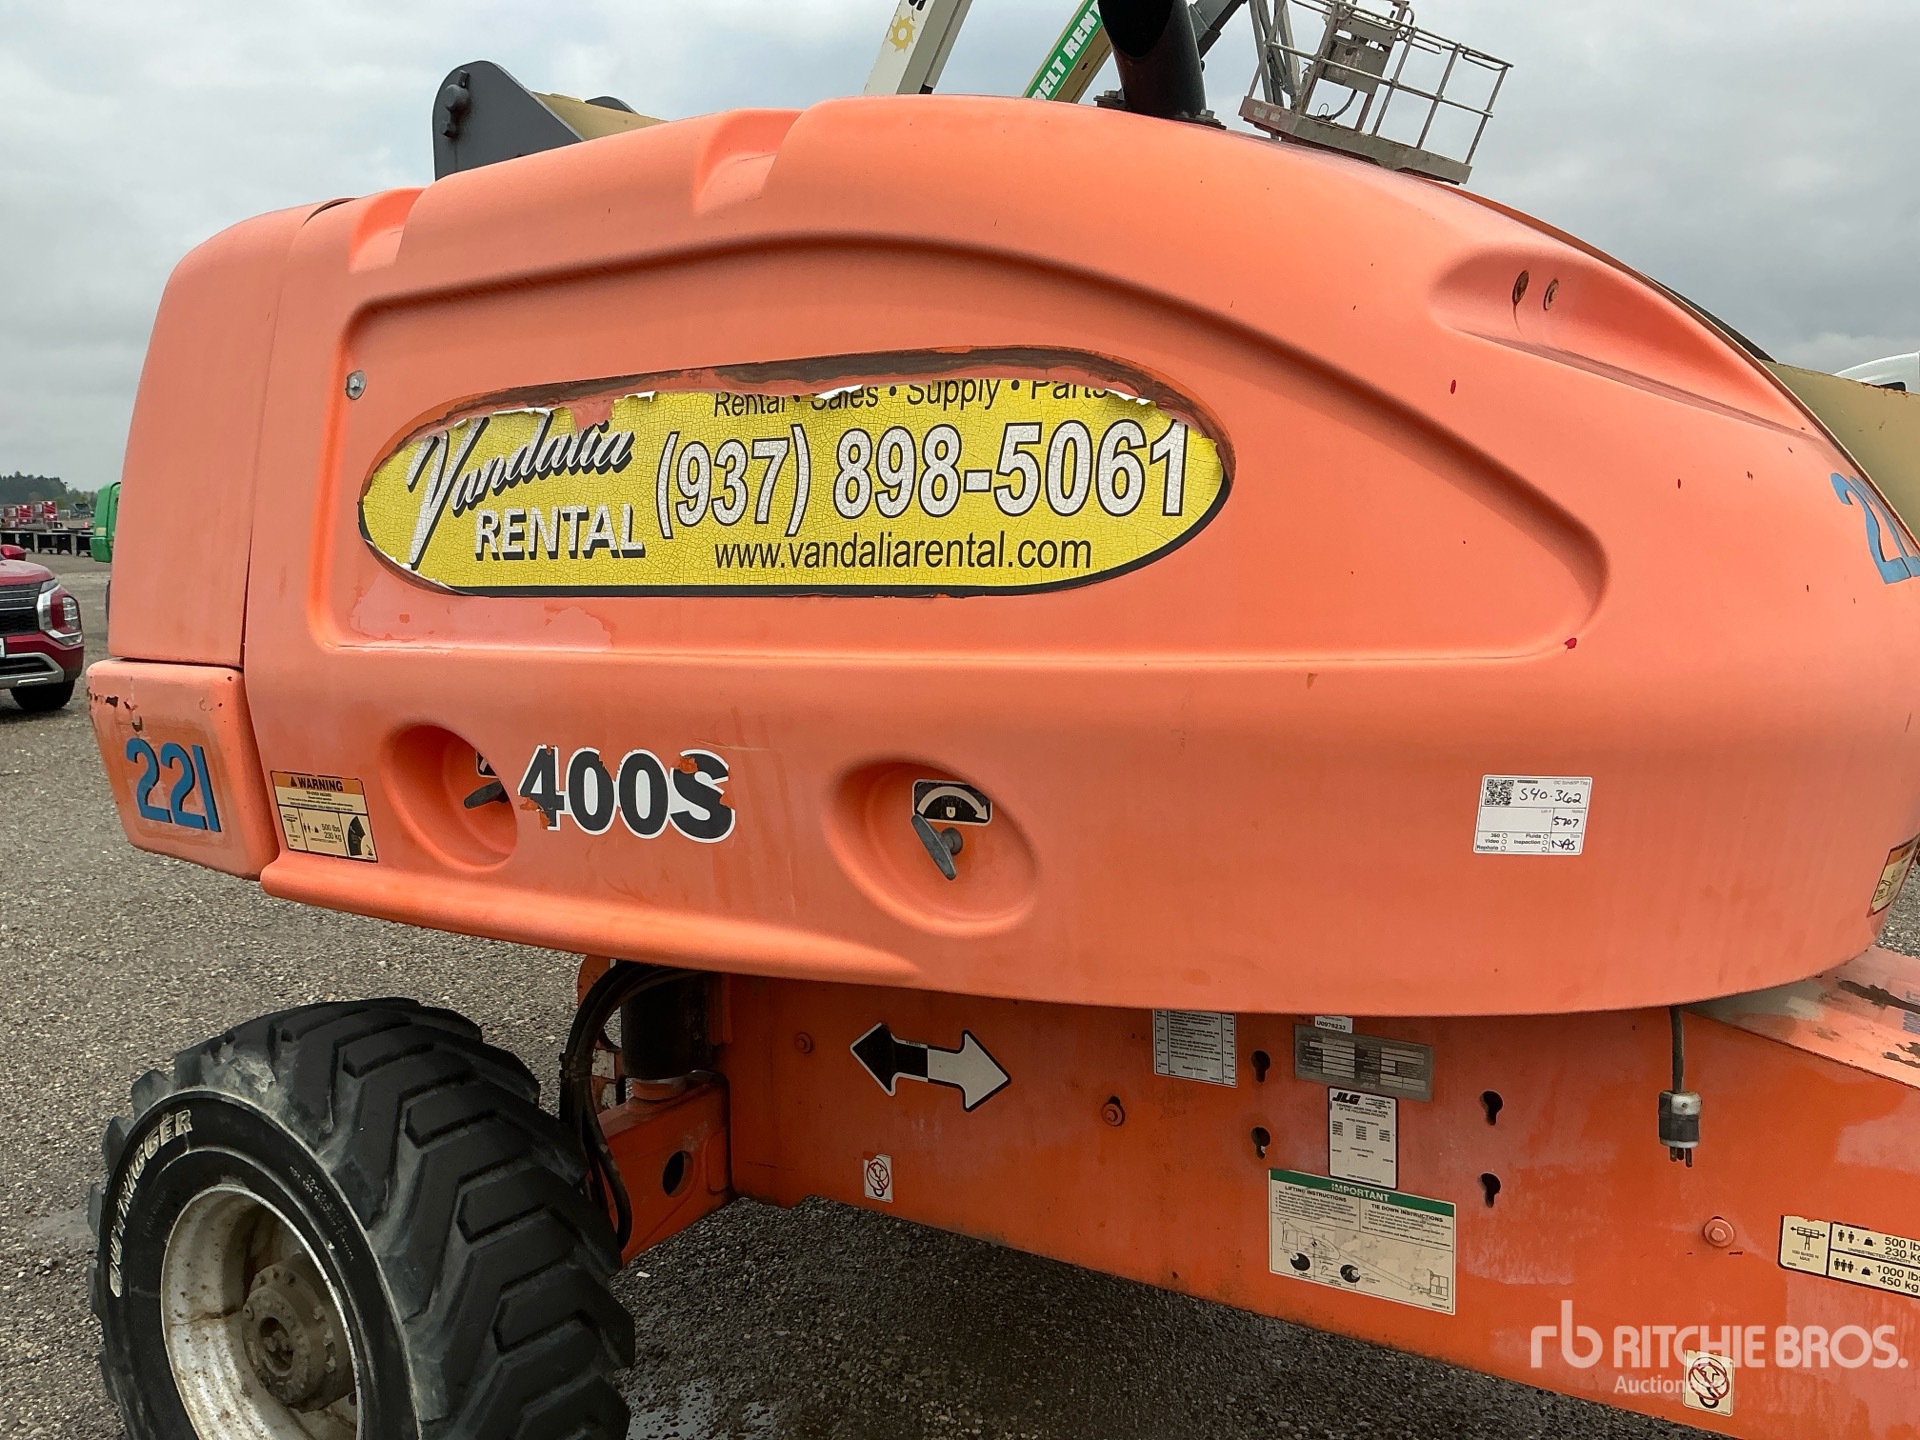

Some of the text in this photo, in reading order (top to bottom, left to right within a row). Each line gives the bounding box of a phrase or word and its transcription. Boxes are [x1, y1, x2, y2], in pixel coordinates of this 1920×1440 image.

[714, 392, 786, 417] Rental
[907, 379, 1001, 411] Supply
[656, 418, 1190, 539] (937) 898-5061
[407, 410, 636, 570] Vandalia
[475, 503, 646, 561] RENTAL
[714, 530, 1092, 570] www.vandaliarental.com
[125, 737, 222, 833] 221
[297, 776, 344, 792] WARNING
[517, 744, 736, 843] 400S
[1332, 1091, 1361, 1105] JLG
[1285, 1185, 1347, 1202] LIFTING INSTRUCTIONS
[1331, 1183, 1390, 1202] IMPORTANT
[1382, 1206, 1400, 1214] DOWN
[1400, 1209, 1444, 1222] INSTRUCTIONS
[1884, 1236, 1906, 1249] 500
[1885, 1246, 1907, 1258] 230
[1876, 1264, 1920, 1281] 1000 lb
[1880, 1276, 1919, 1293] 450 kg
